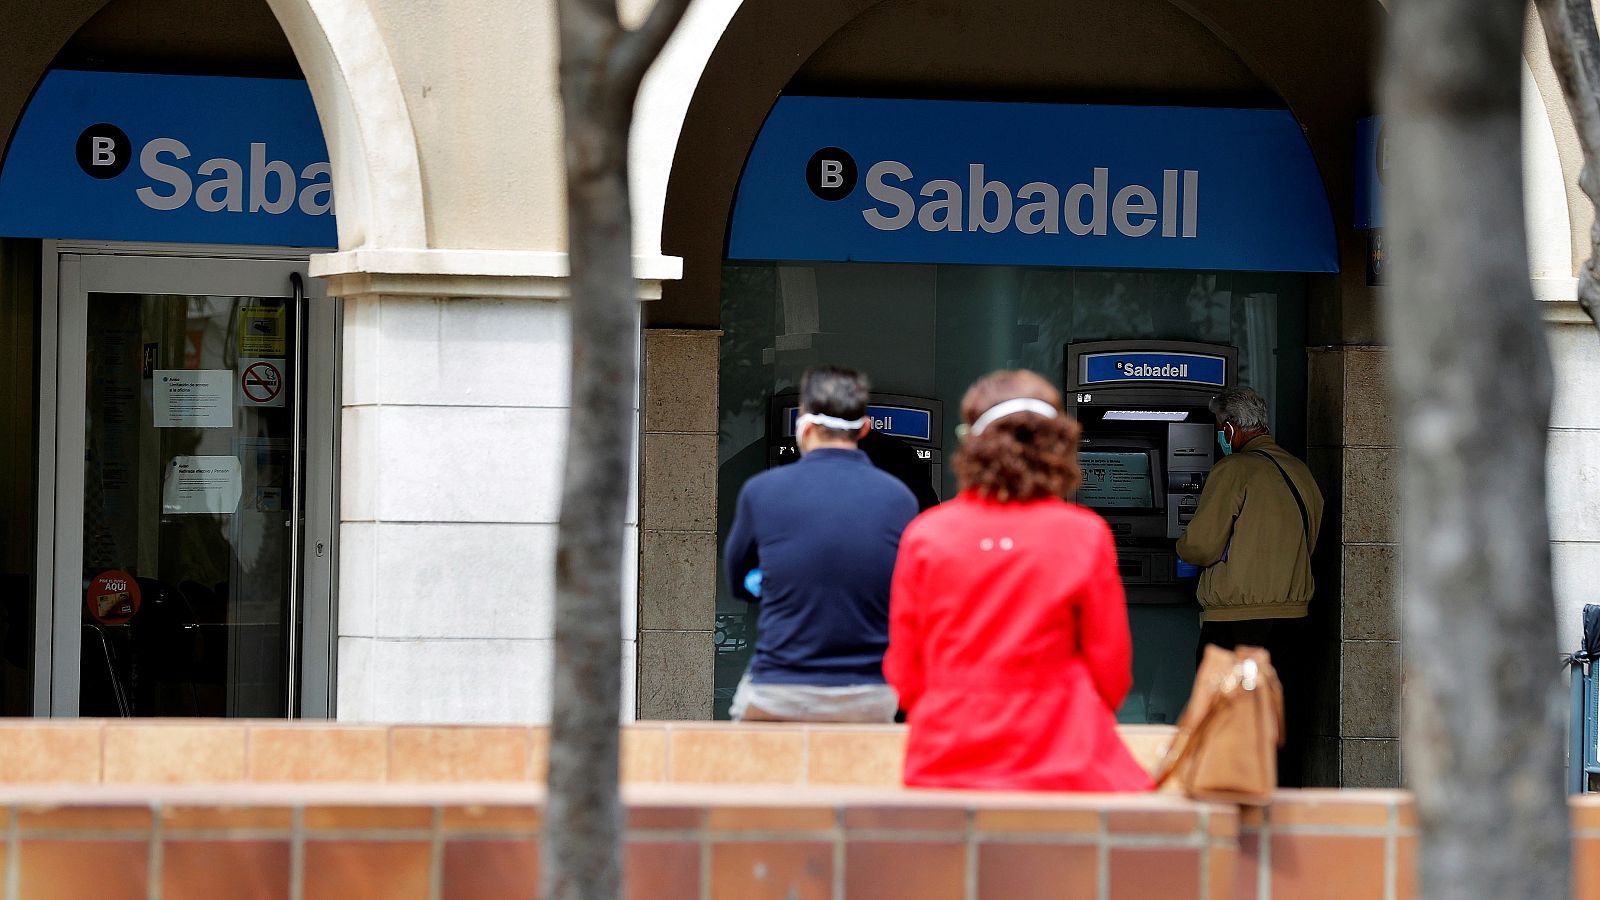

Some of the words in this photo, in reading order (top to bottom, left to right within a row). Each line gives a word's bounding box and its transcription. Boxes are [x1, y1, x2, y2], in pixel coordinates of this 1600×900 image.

[92, 136, 116, 166] B
[136, 137, 337, 216] Saba
[821, 159, 844, 188] B
[862, 160, 1199, 238] Sabadell
[1123, 362, 1188, 378] Sabadell
